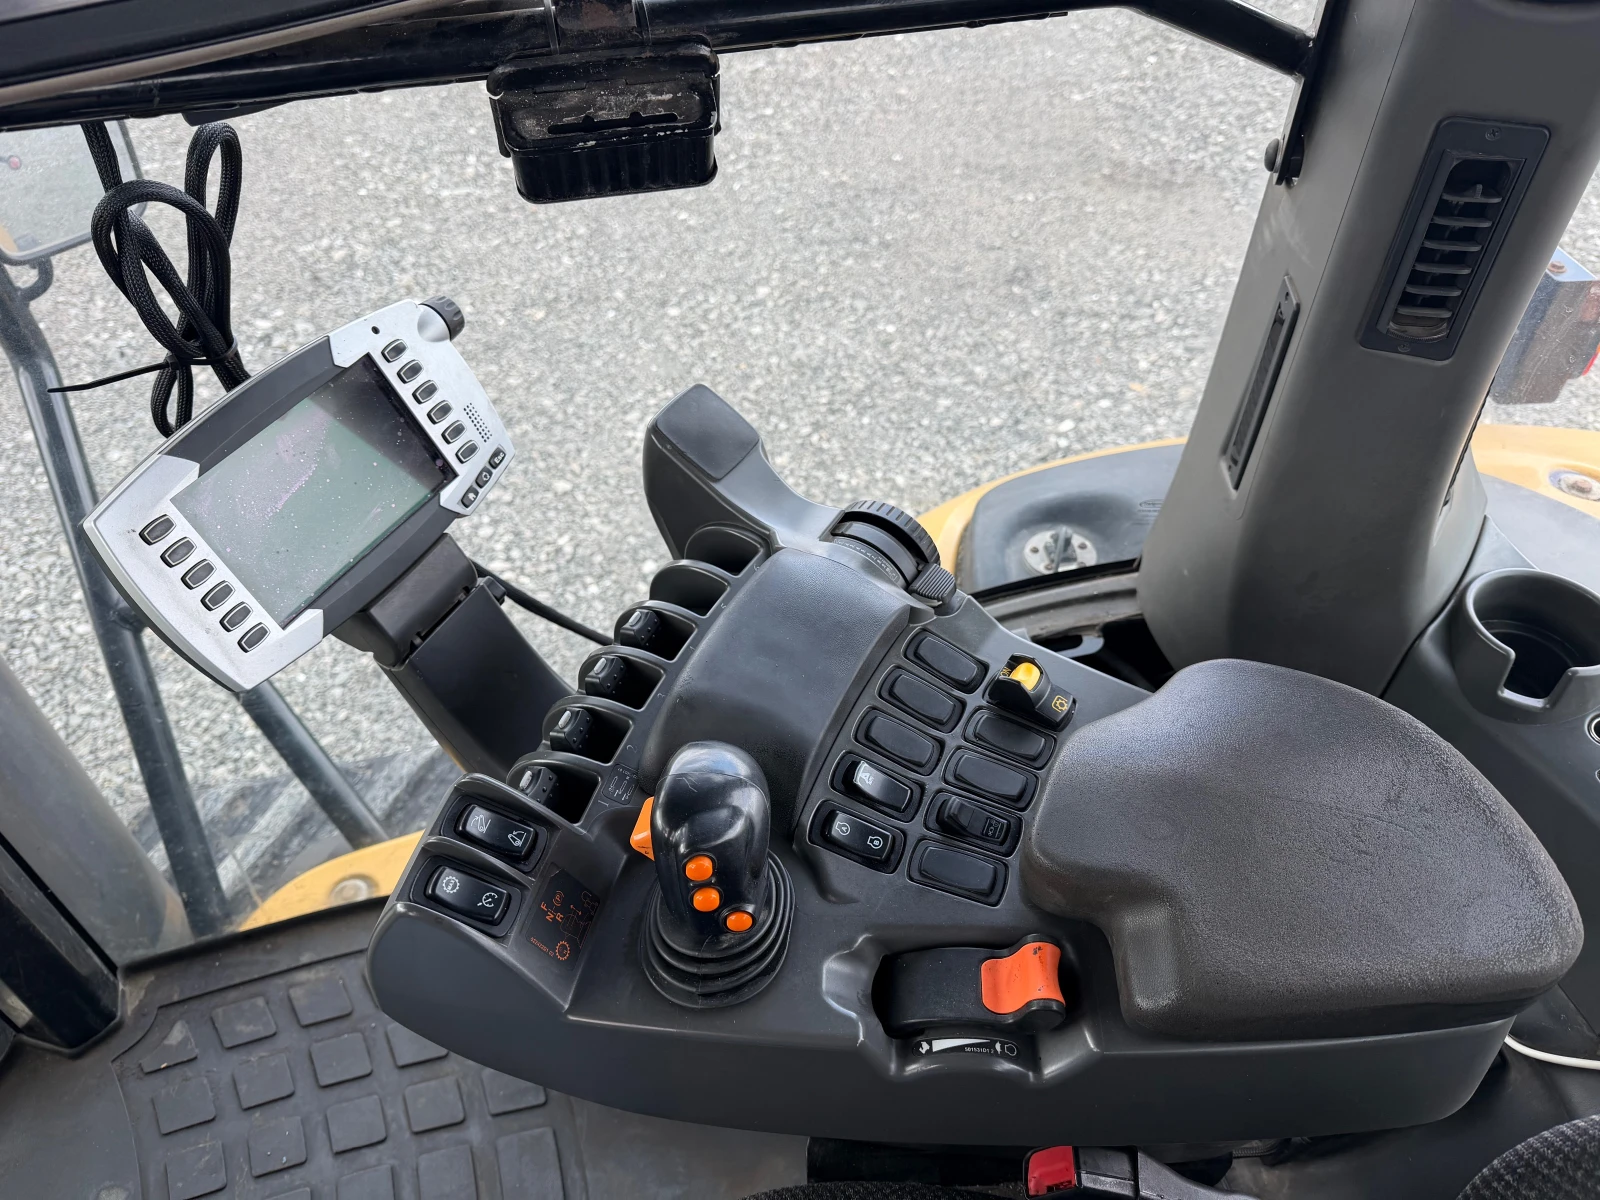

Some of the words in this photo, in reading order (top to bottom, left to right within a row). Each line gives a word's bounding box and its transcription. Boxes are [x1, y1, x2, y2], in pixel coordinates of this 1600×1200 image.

[494, 451, 505, 464] Esc
[540, 901, 548, 911] F
[545, 911, 555, 922] N
[555, 912, 564, 922] R
